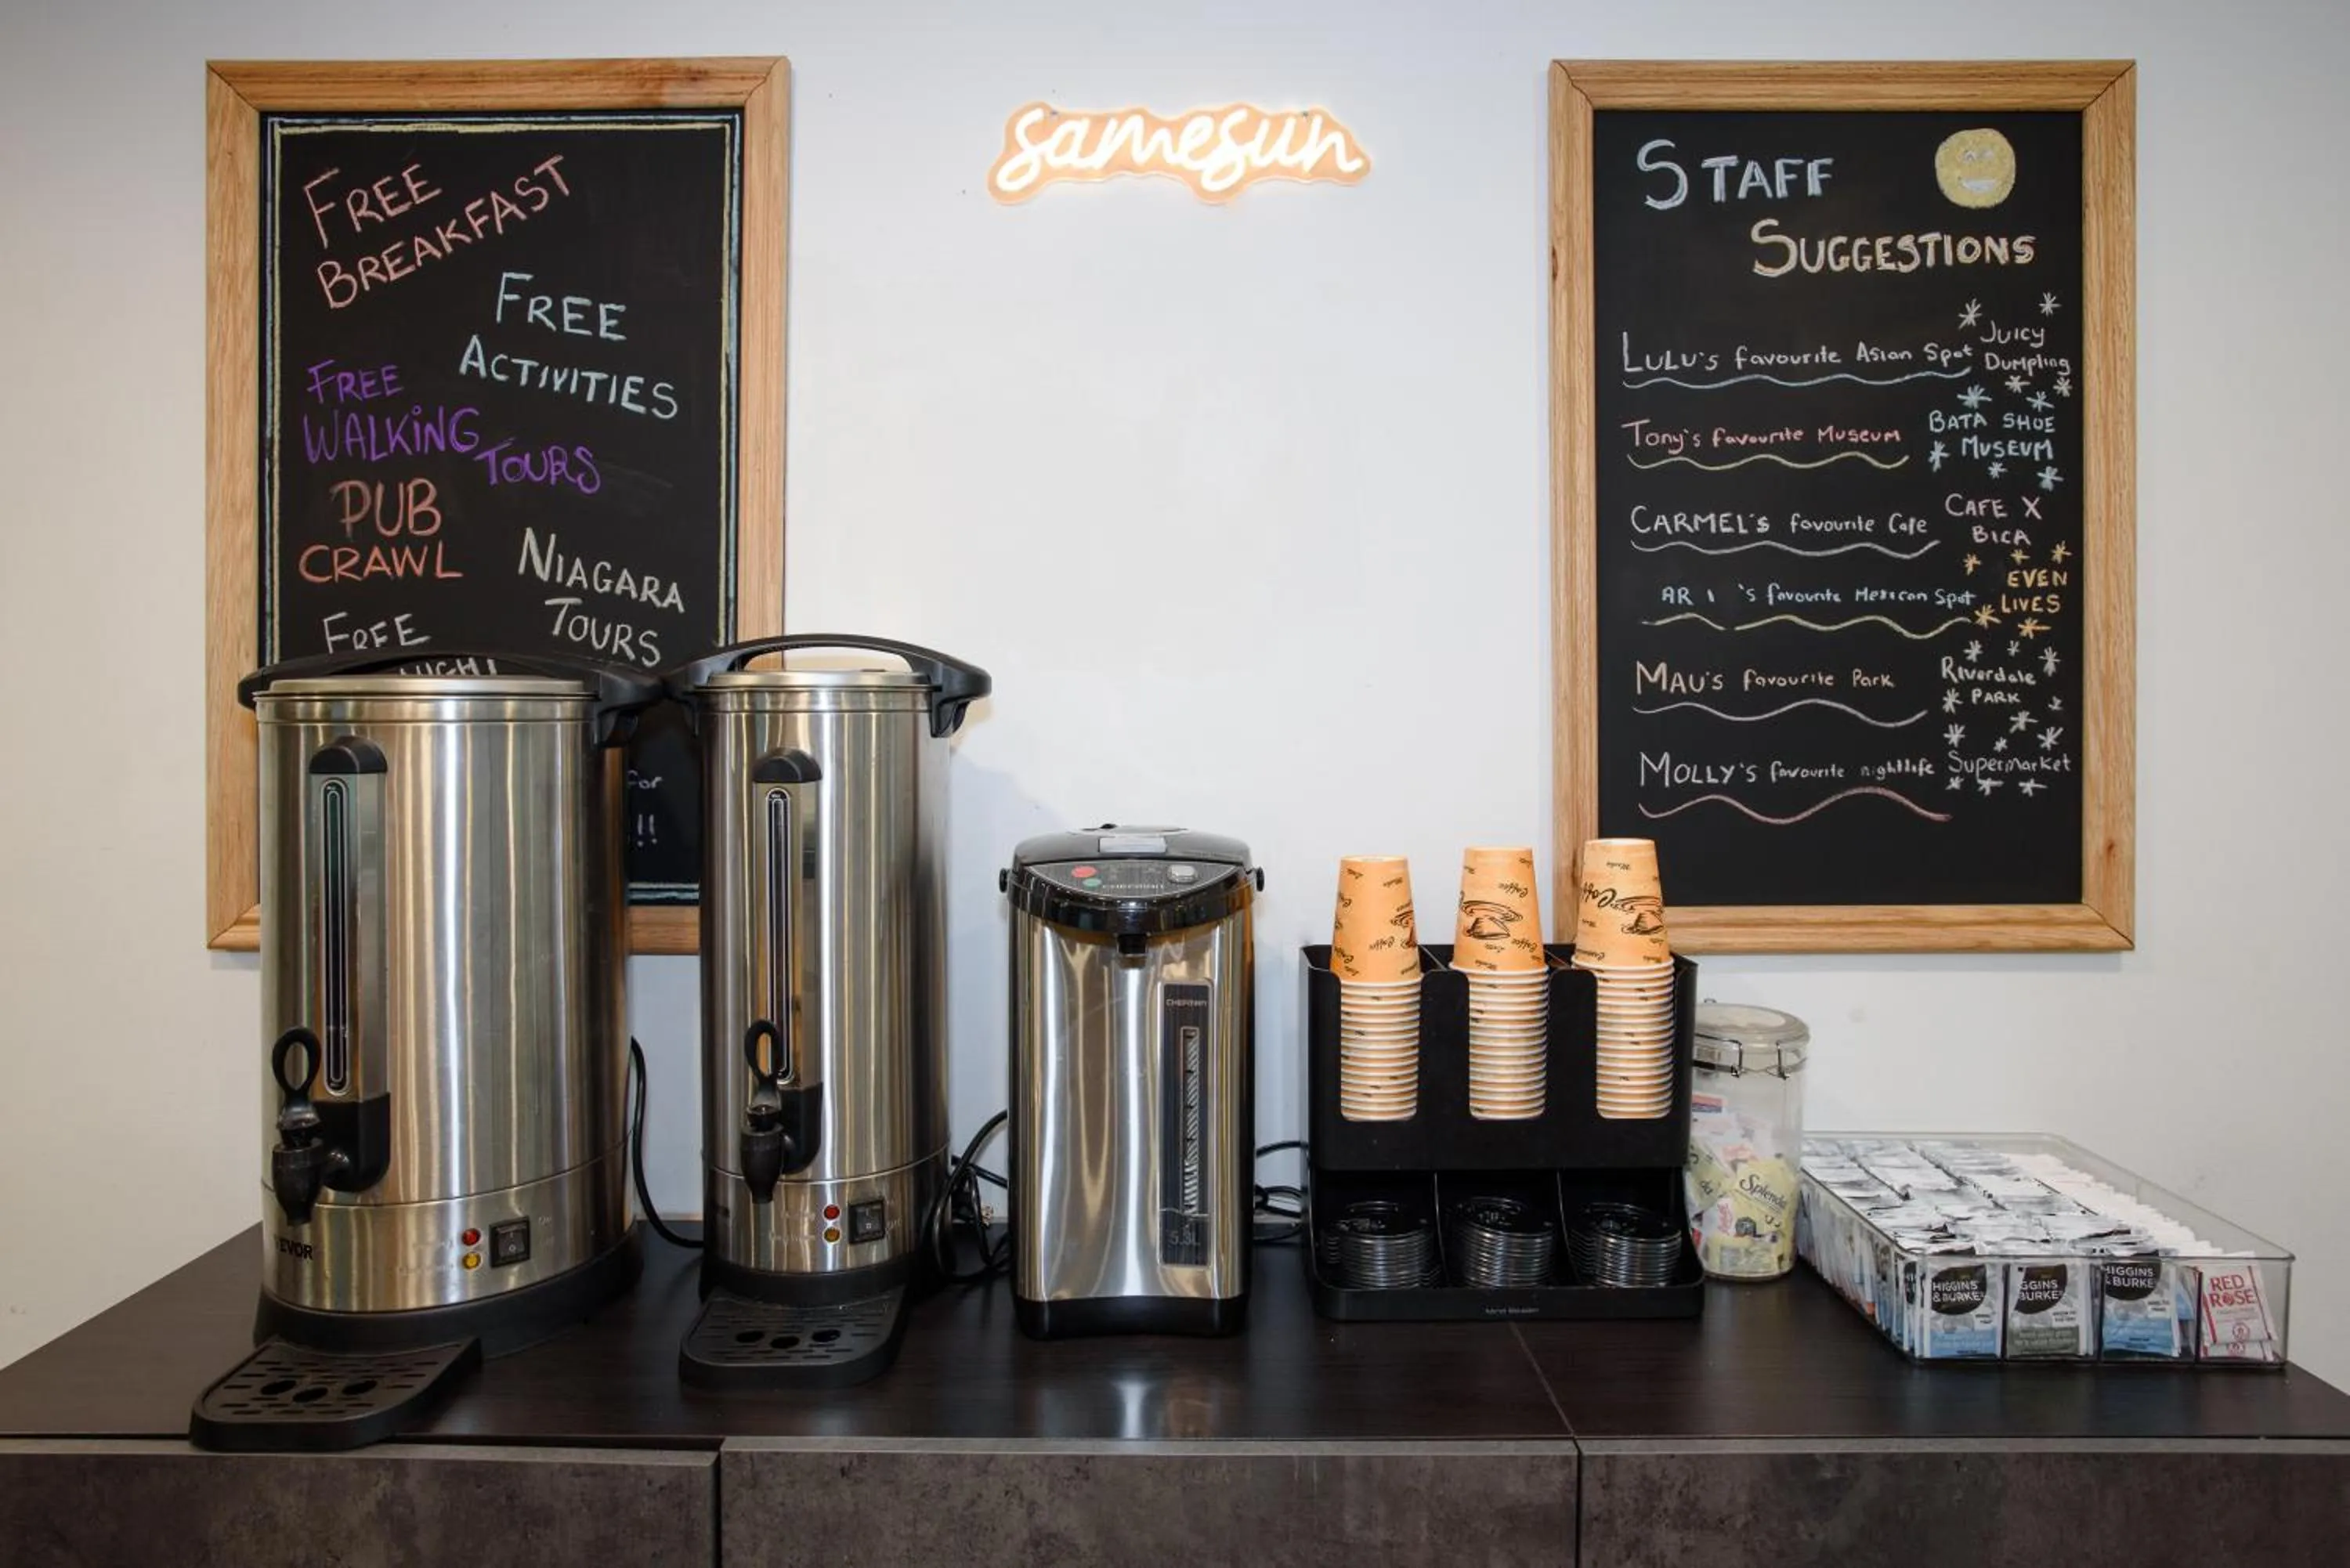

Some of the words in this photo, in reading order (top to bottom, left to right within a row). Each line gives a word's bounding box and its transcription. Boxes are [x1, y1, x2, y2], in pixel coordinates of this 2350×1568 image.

[996, 107, 1364, 192] samesun
[1636, 139, 1834, 210] STAFF
[303, 163, 442, 249] FREE
[317, 155, 570, 309] BREAKFAST
[1750, 219, 2036, 277] SUGGESTIONS
[496, 272, 627, 340] FREE
[1735, 345, 1842, 370] favourite
[1856, 342, 1912, 363] Asian
[1923, 342, 1973, 367] Spot
[307, 359, 405, 403] FREE
[459, 334, 678, 419] ACTIVITIES
[1929, 410, 1988, 432] BATA
[2002, 413, 2055, 432] SHOE
[1712, 428, 1804, 448] favourite
[1961, 435, 2054, 461] MUSEUM
[473, 437, 601, 494] TOURS
[331, 477, 442, 540] PUB
[1945, 493, 2008, 518] CAFE
[1790, 513, 1875, 534] favourite
[1889, 513, 1928, 534] Cafe
[1972, 525, 2031, 546] BICA
[298, 540, 462, 583] CRAWL
[518, 527, 685, 614] NIAGARA
[2007, 569, 2068, 588] EVEN
[1767, 583, 1842, 606] favourite
[1935, 589, 1976, 609] Spot
[2001, 593, 2061, 613] LIVES
[545, 597, 661, 667] TOURS
[1743, 669, 1835, 692] favourite
[1852, 669, 1895, 688] Park
[1972, 688, 2021, 704] PARK
[1770, 761, 1844, 782] favourite
[1860, 758, 1935, 780] nightlife
[1948, 750, 2071, 782] Supermarket
[1932, 1280, 1978, 1292] HIGGINS
[2021, 1279, 2058, 1290] GGINS
[2113, 1277, 2155, 1288] BURKE
[2210, 1274, 2245, 1292] RED
[1942, 1292, 1981, 1302] BURKE
[2209, 1288, 2257, 1308] ROSE
